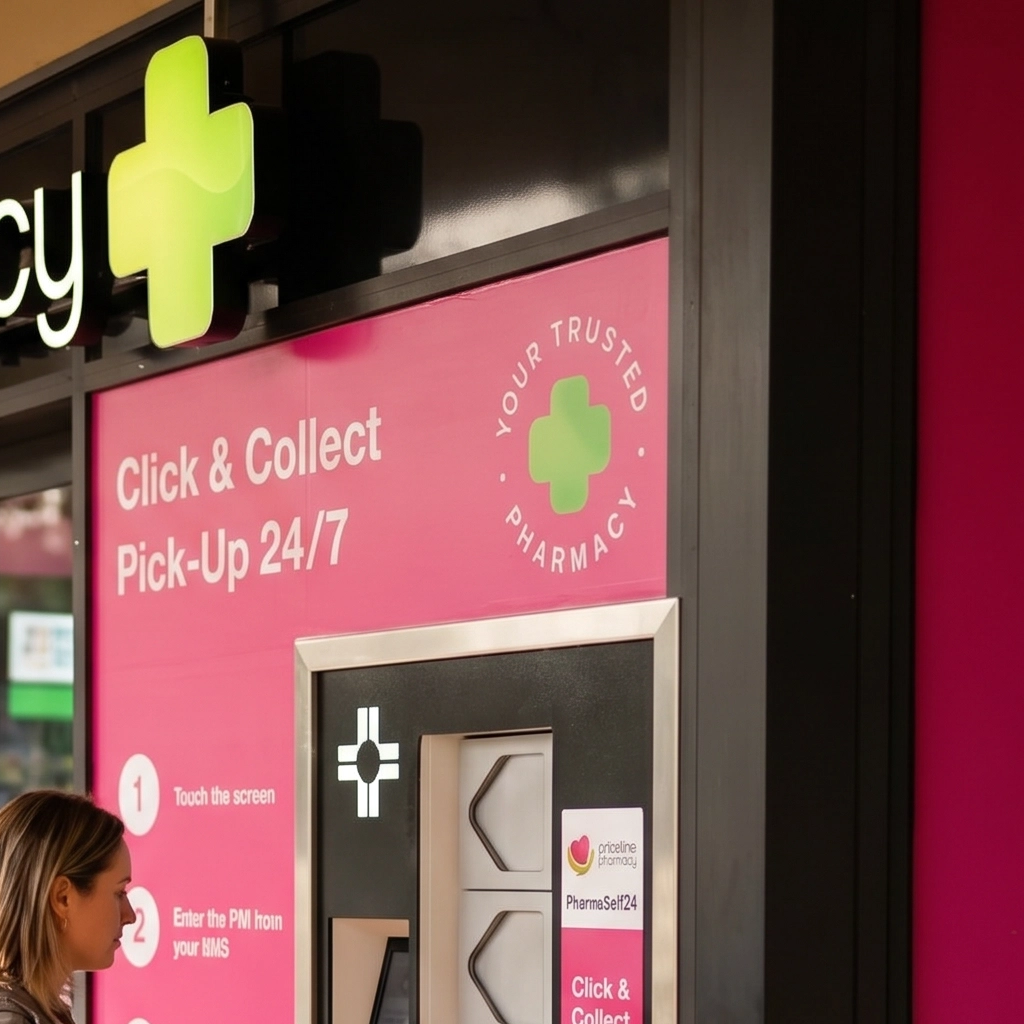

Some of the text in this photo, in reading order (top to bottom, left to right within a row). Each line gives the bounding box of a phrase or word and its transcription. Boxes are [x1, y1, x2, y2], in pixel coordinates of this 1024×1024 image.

[495, 315, 648, 438] YOUR TRUSTED
[116, 406, 382, 512] Click & Collect
[505, 486, 637, 574] PHARMACY
[117, 508, 349, 596] Pick-Up 24/7
[133, 775, 143, 813] 1
[173, 785, 276, 807] Touch the screen
[173, 906, 206, 928] Enter
[207, 908, 226, 928] the
[566, 893, 638, 911] PharmaSelf24
[133, 907, 146, 943] 2
[173, 940, 200, 960] your
[571, 975, 631, 1001] Click &
